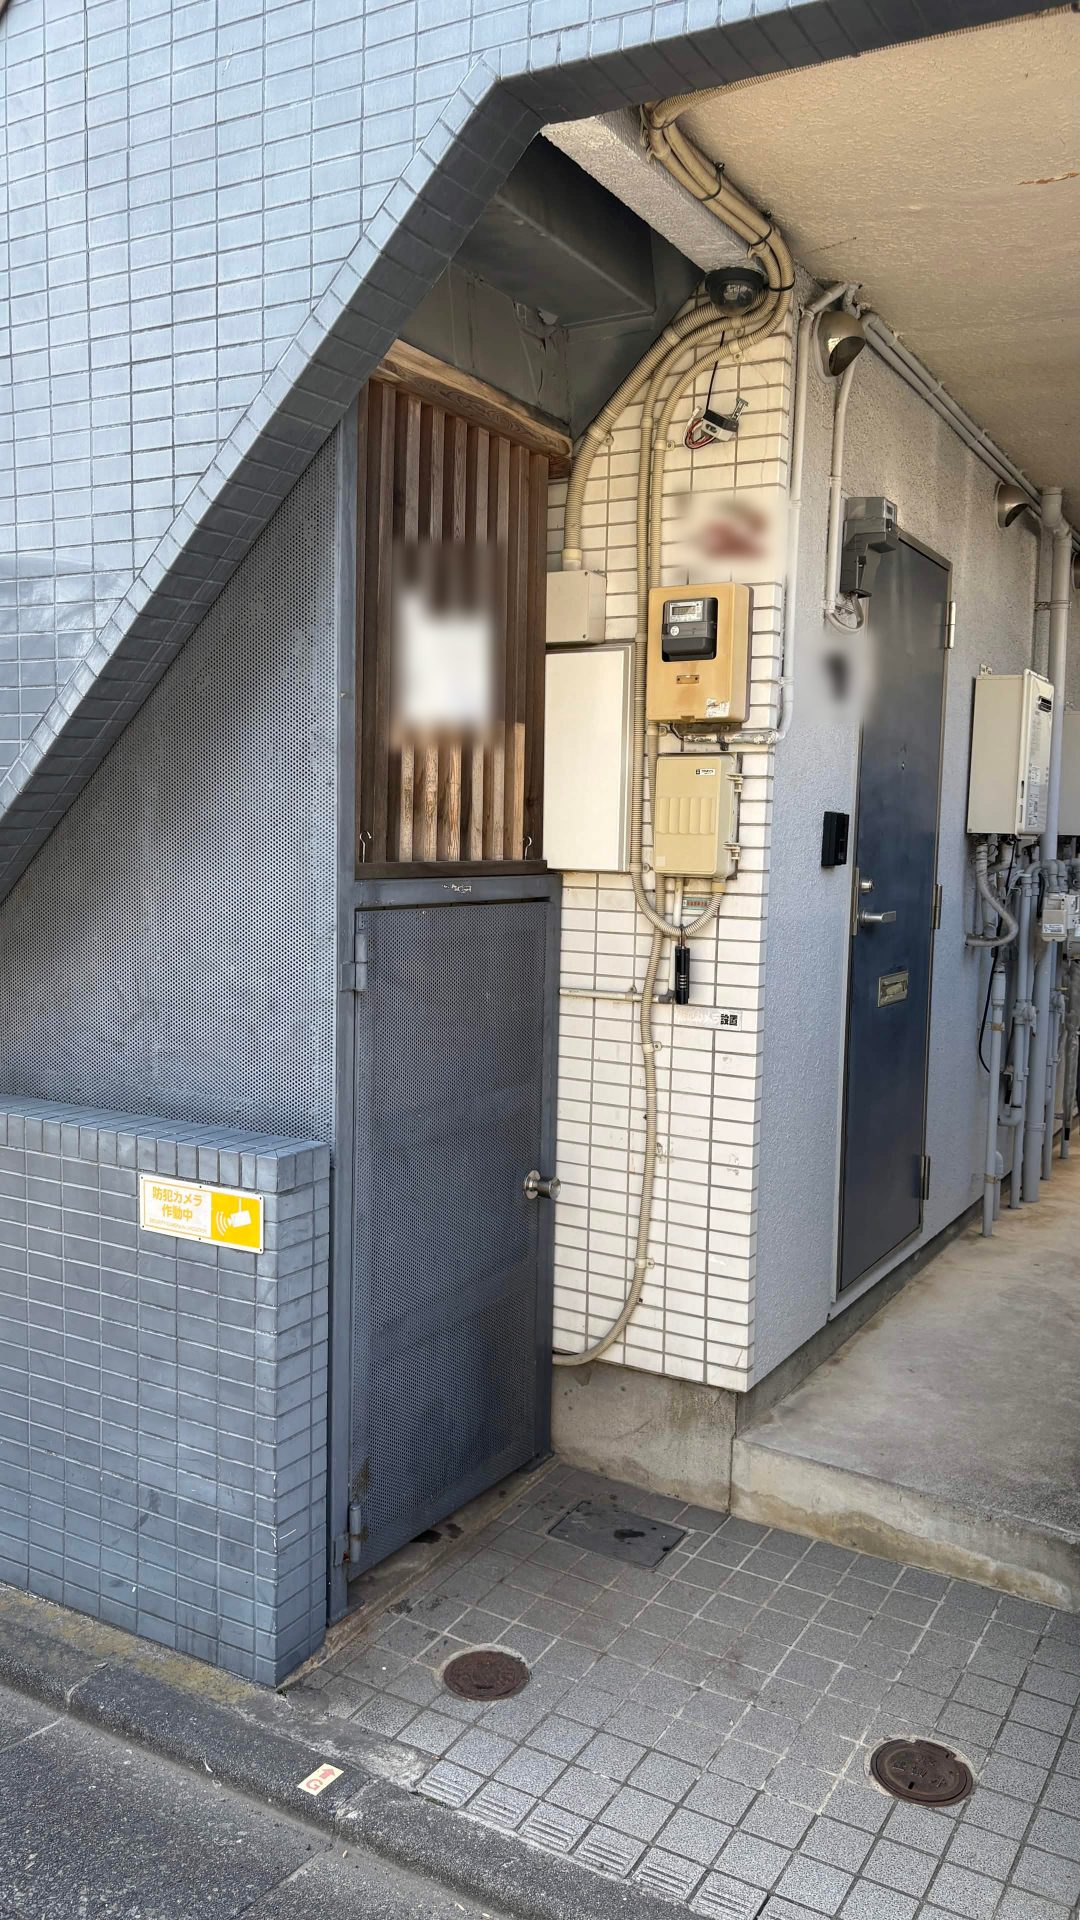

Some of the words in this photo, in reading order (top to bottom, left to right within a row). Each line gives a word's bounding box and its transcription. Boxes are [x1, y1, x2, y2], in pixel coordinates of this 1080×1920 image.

[720, 1013, 738, 1026] 設置
[152, 1186, 203, 1207] 防犯カメラ
[161, 1204, 193, 1222] 作動中
[305, 1778, 324, 1791] G
